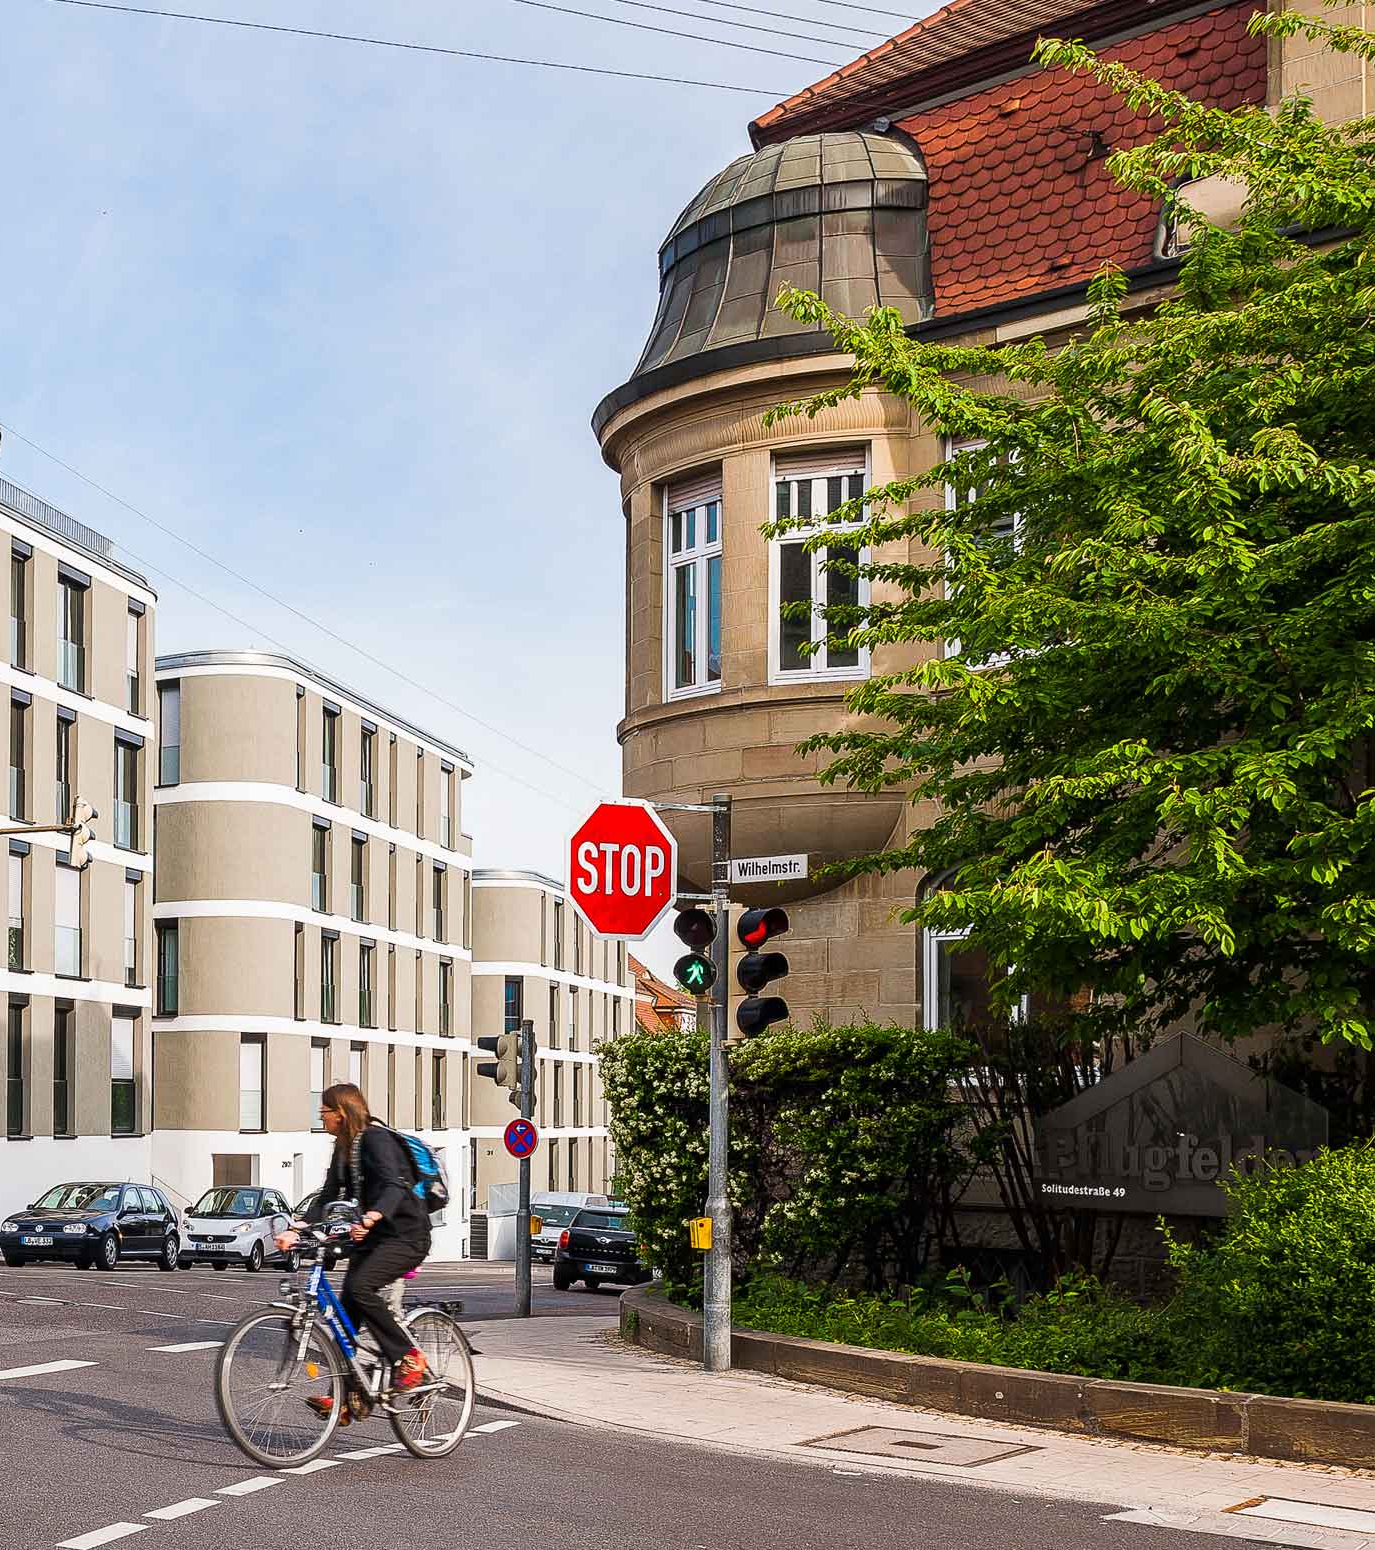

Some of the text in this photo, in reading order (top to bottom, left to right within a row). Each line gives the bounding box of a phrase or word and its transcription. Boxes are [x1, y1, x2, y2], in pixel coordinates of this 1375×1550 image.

[576, 840, 666, 898] STOP
[737, 859, 802, 878] Wilhelmstr.
[1041, 1183, 1126, 1198] Solitudestraße 49
